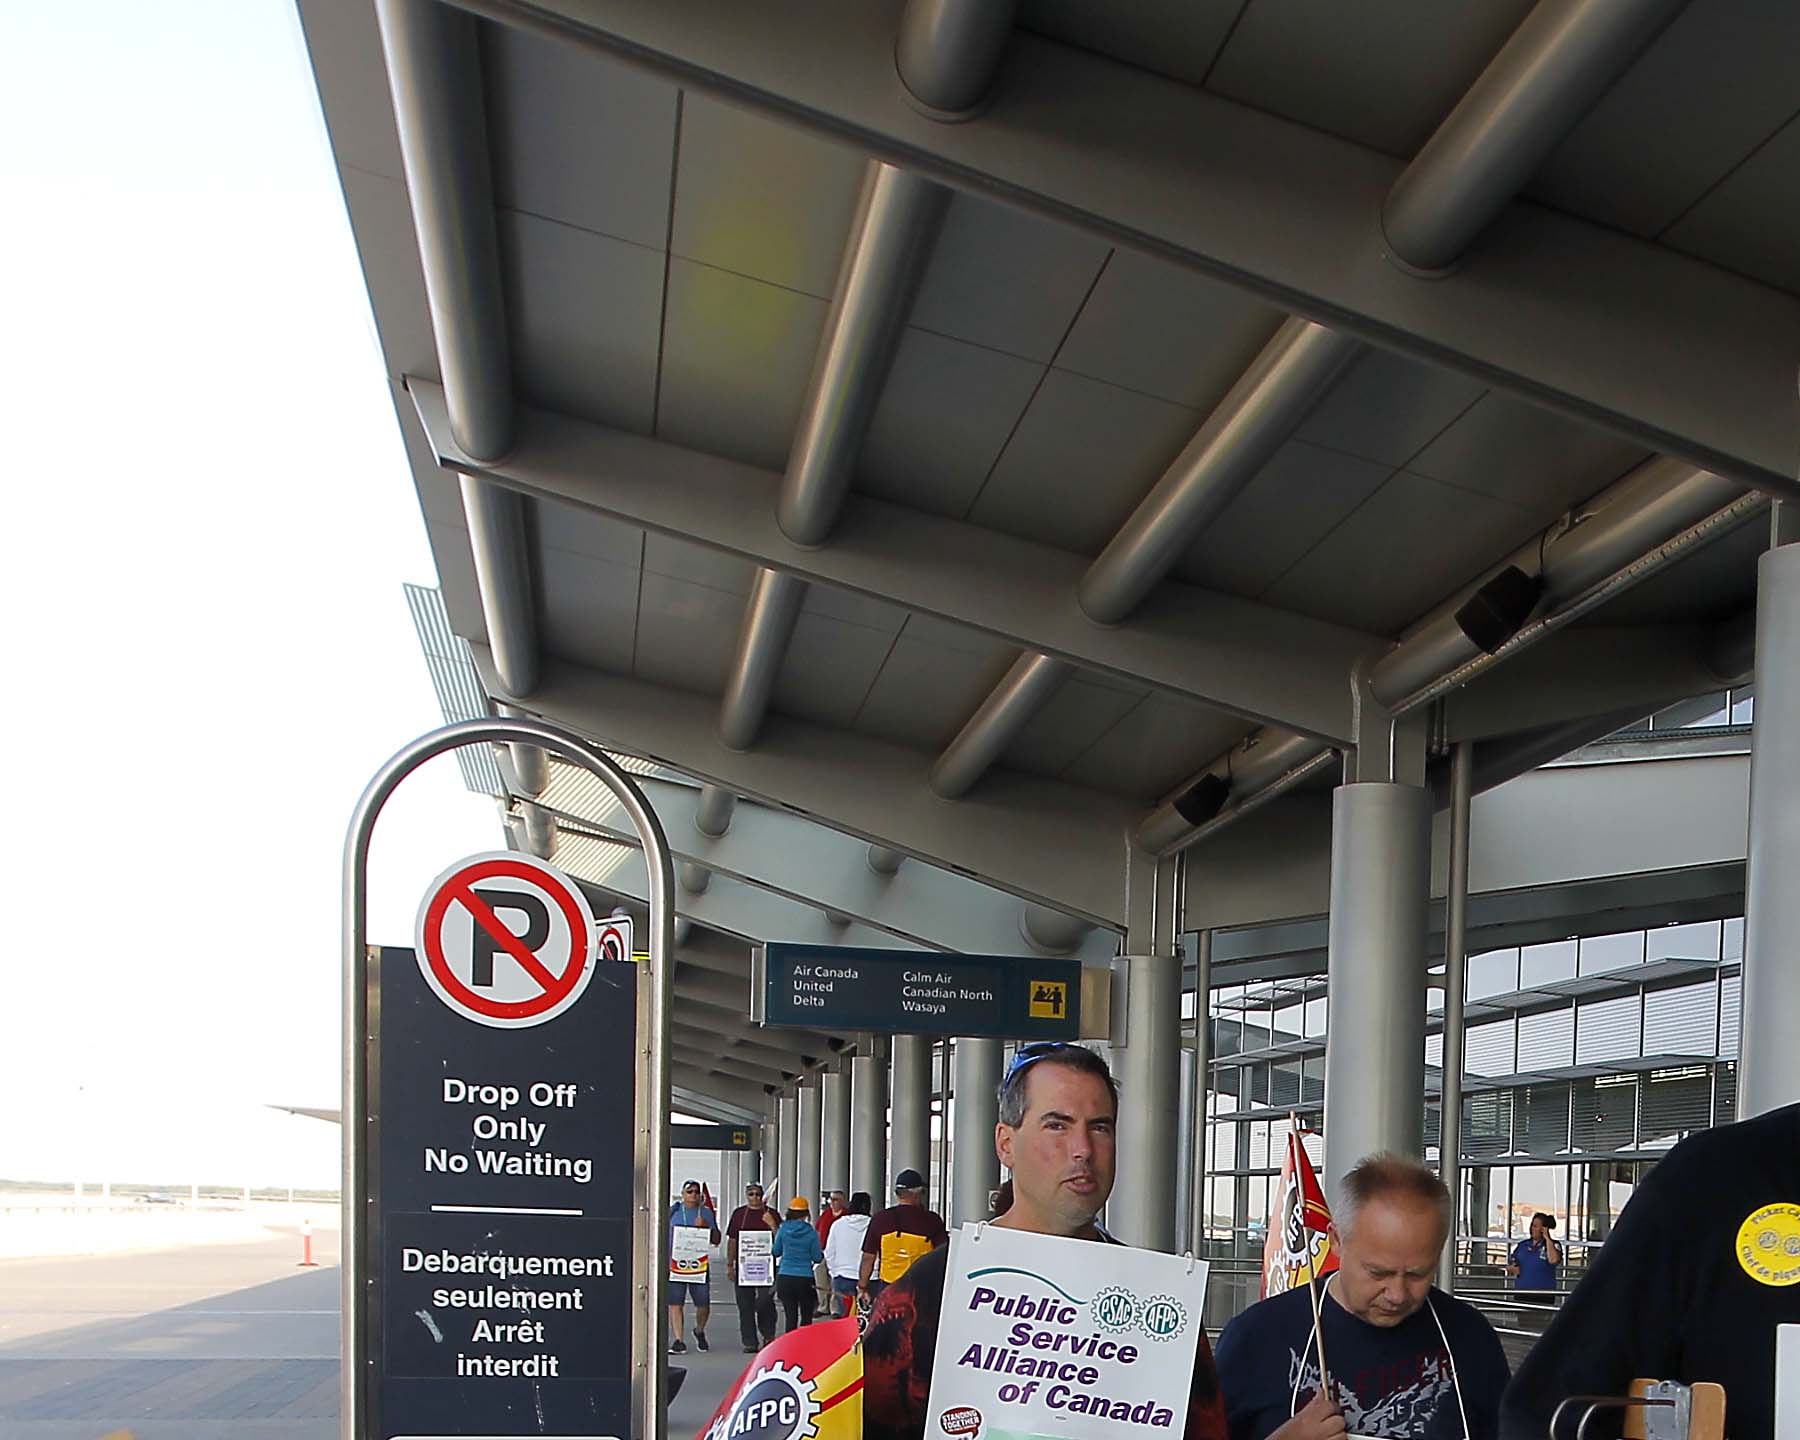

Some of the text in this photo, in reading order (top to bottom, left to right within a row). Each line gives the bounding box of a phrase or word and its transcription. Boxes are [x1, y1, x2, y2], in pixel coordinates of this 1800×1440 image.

[793, 965, 859, 979] Air Canada
[793, 981, 833, 992] United
[903, 972, 952, 984] Calm Air
[793, 995, 825, 1007] Delta
[903, 986, 993, 1001] Canadian North
[903, 1001, 946, 1015] Wasaya
[443, 1079, 577, 1110] Drop Off
[473, 1115, 546, 1147] Only
[425, 1149, 593, 1183] No Waiting
[402, 1249, 614, 1279] Debarquement
[432, 1285, 583, 1310] seulement
[968, 1286, 1078, 1325] Public
[1100, 1296, 1133, 1326] PSAC
[472, 1319, 545, 1343] Arrêt
[1008, 1322, 1138, 1364] Service
[457, 1354, 559, 1377] interdit
[958, 1343, 1100, 1385] Alliance
[731, 1396, 796, 1437] AFPC
[999, 1381, 1174, 1428] of Canada
